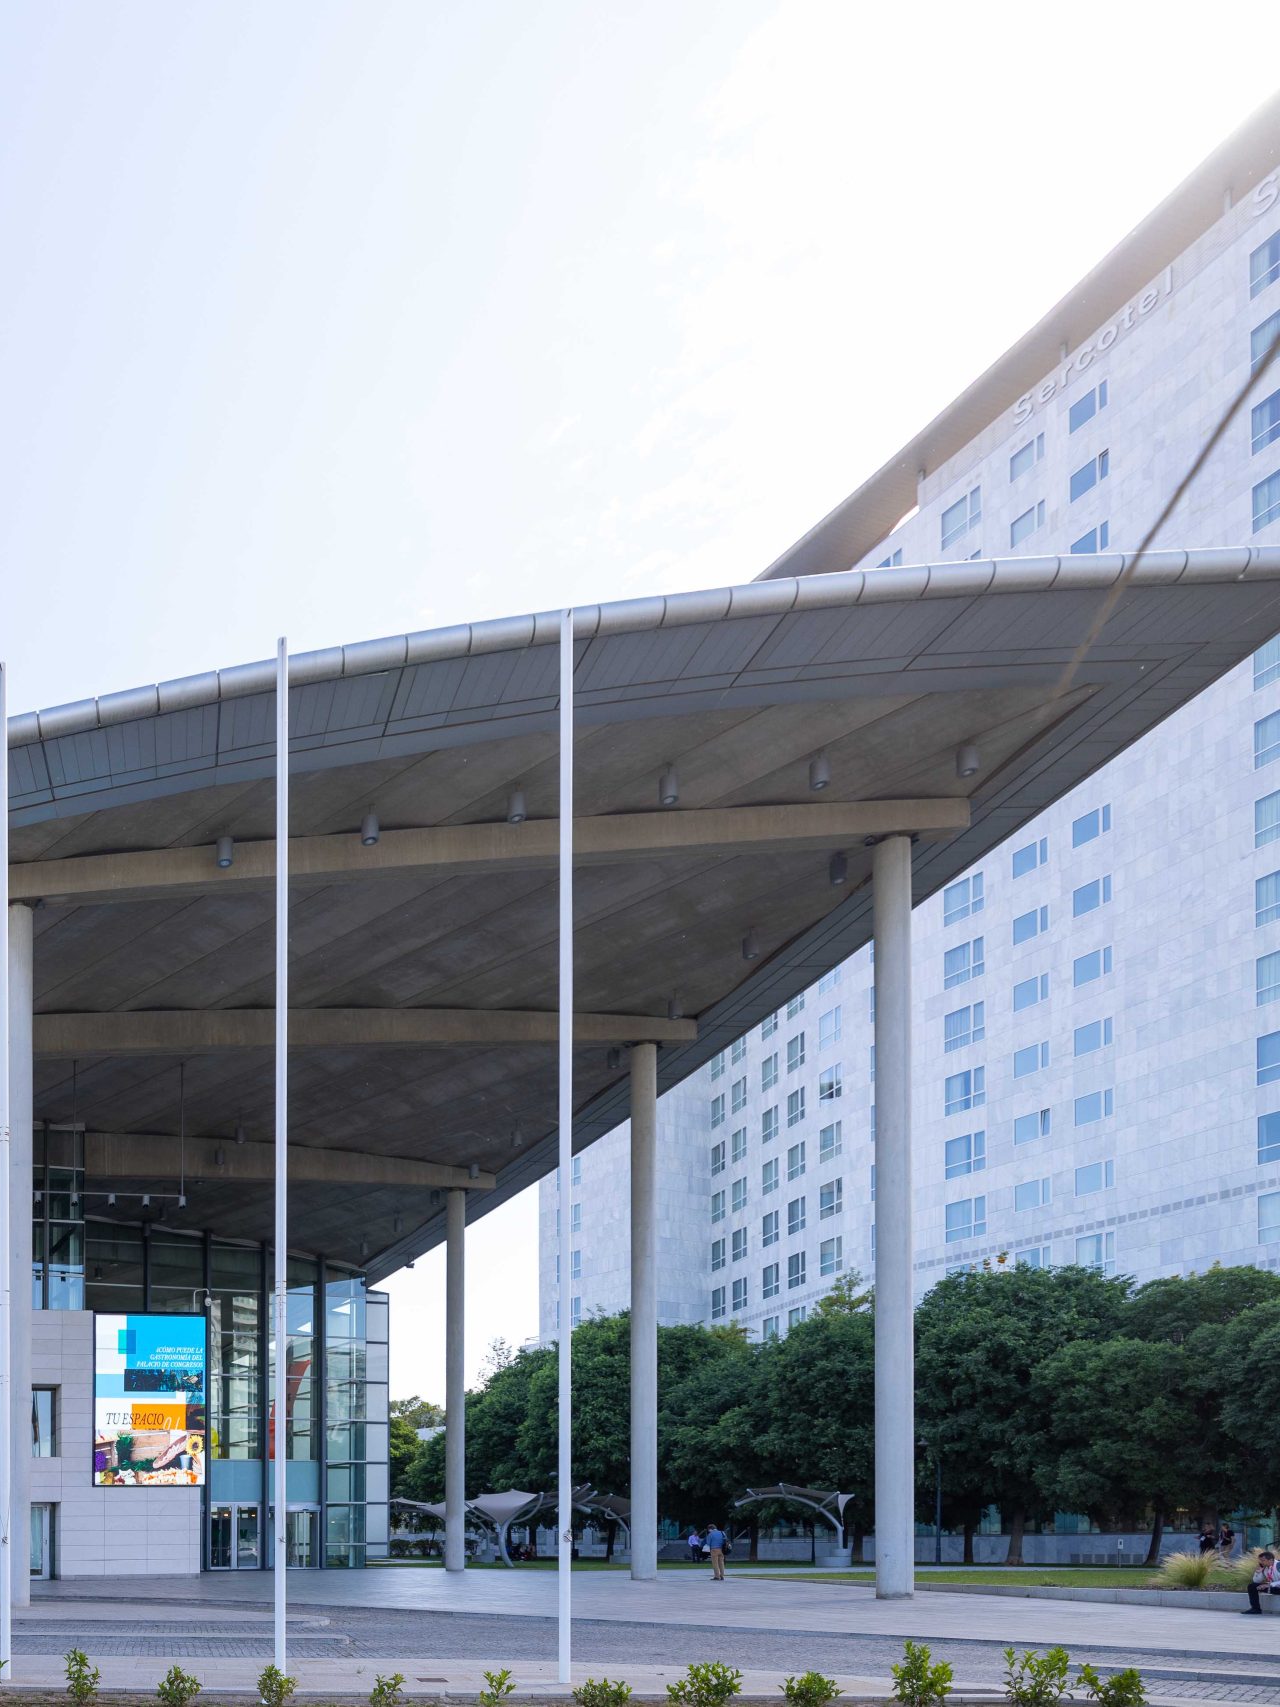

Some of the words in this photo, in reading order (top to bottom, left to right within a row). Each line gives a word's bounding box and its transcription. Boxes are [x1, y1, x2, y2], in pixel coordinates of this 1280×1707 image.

[1013, 265, 1174, 427] Sercotel
[106, 1412, 121, 1425] TU
[122, 1413, 165, 1426] ESPACIO
